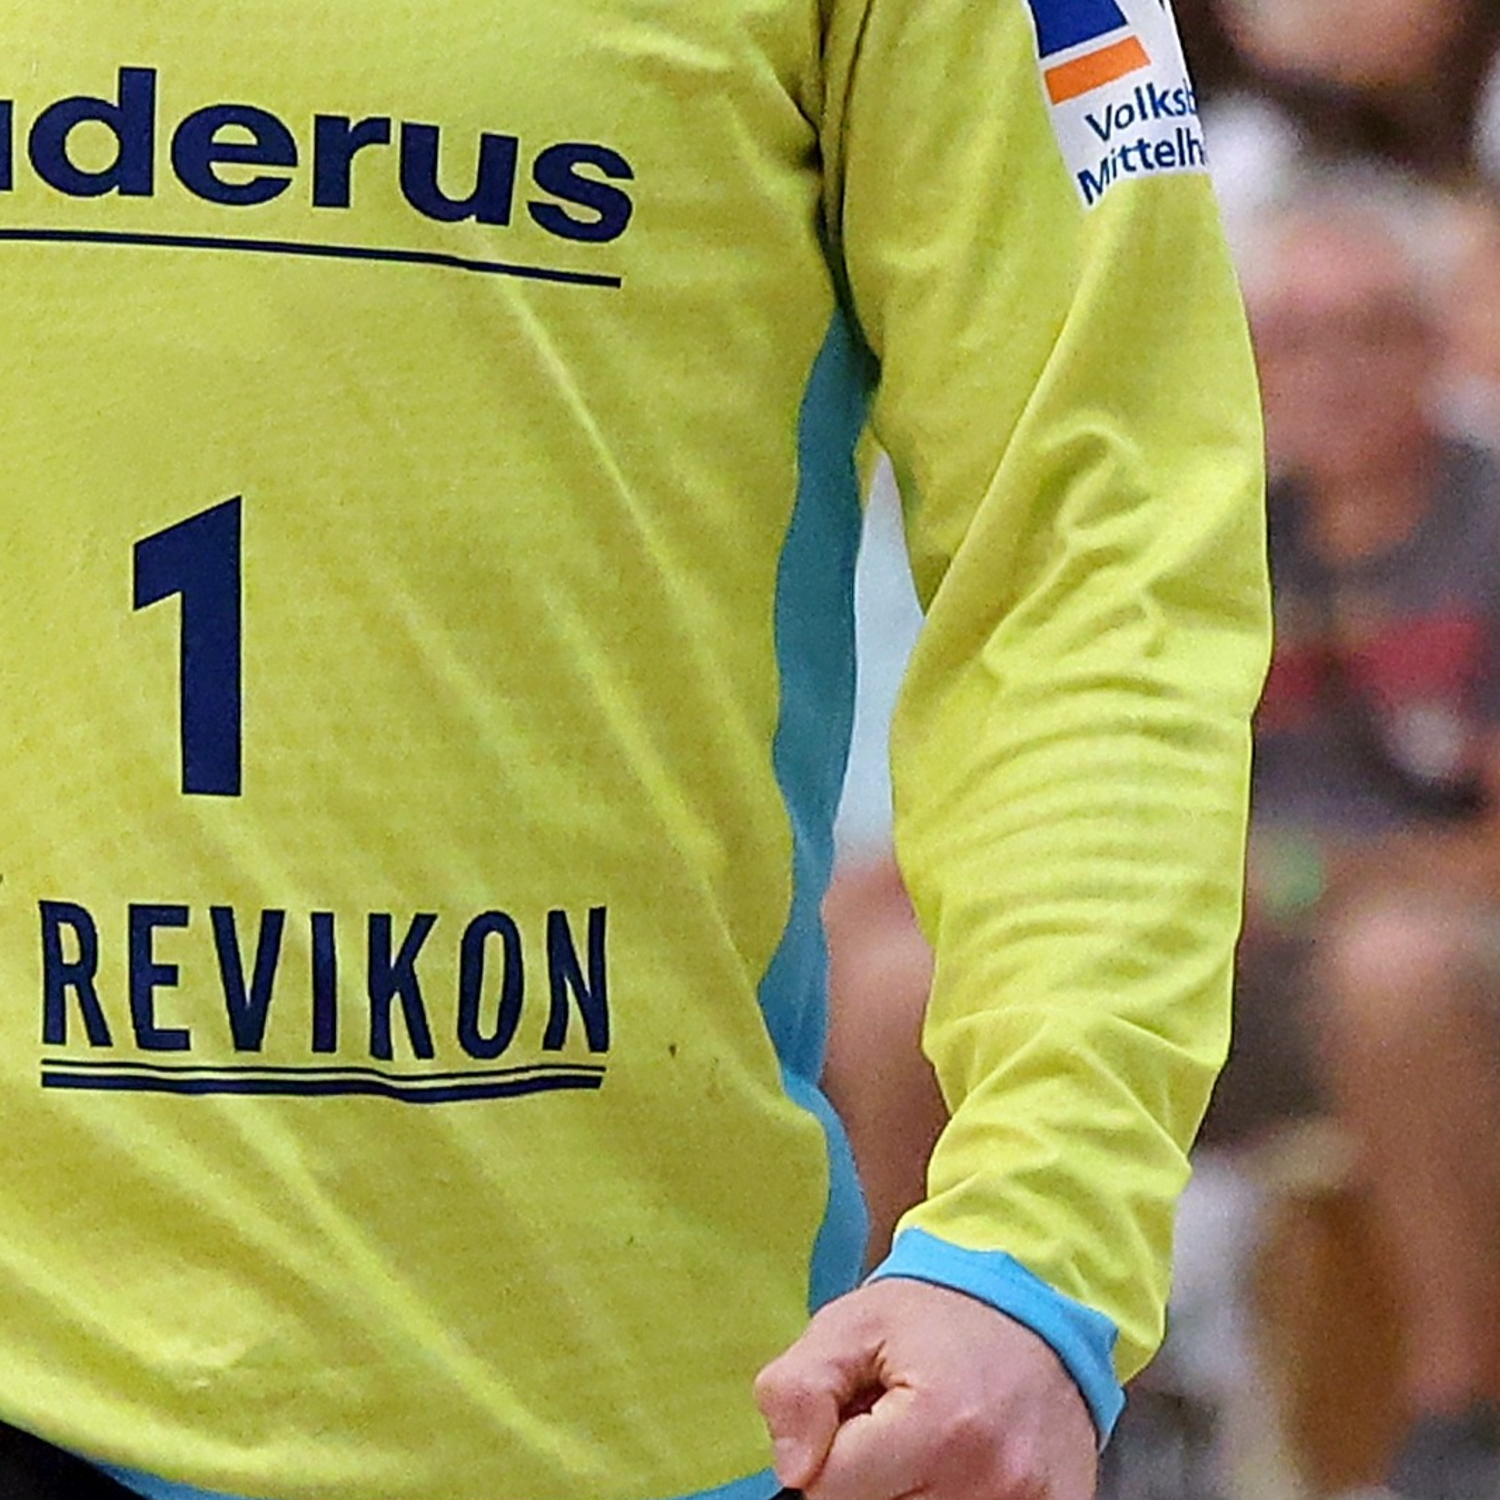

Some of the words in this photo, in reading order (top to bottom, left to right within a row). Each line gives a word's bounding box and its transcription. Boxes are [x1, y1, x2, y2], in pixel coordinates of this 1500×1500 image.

[1077, 127, 1206, 205] Mittelh
[133, 495, 242, 797] 1
[39, 899, 611, 1060] REVIKON
